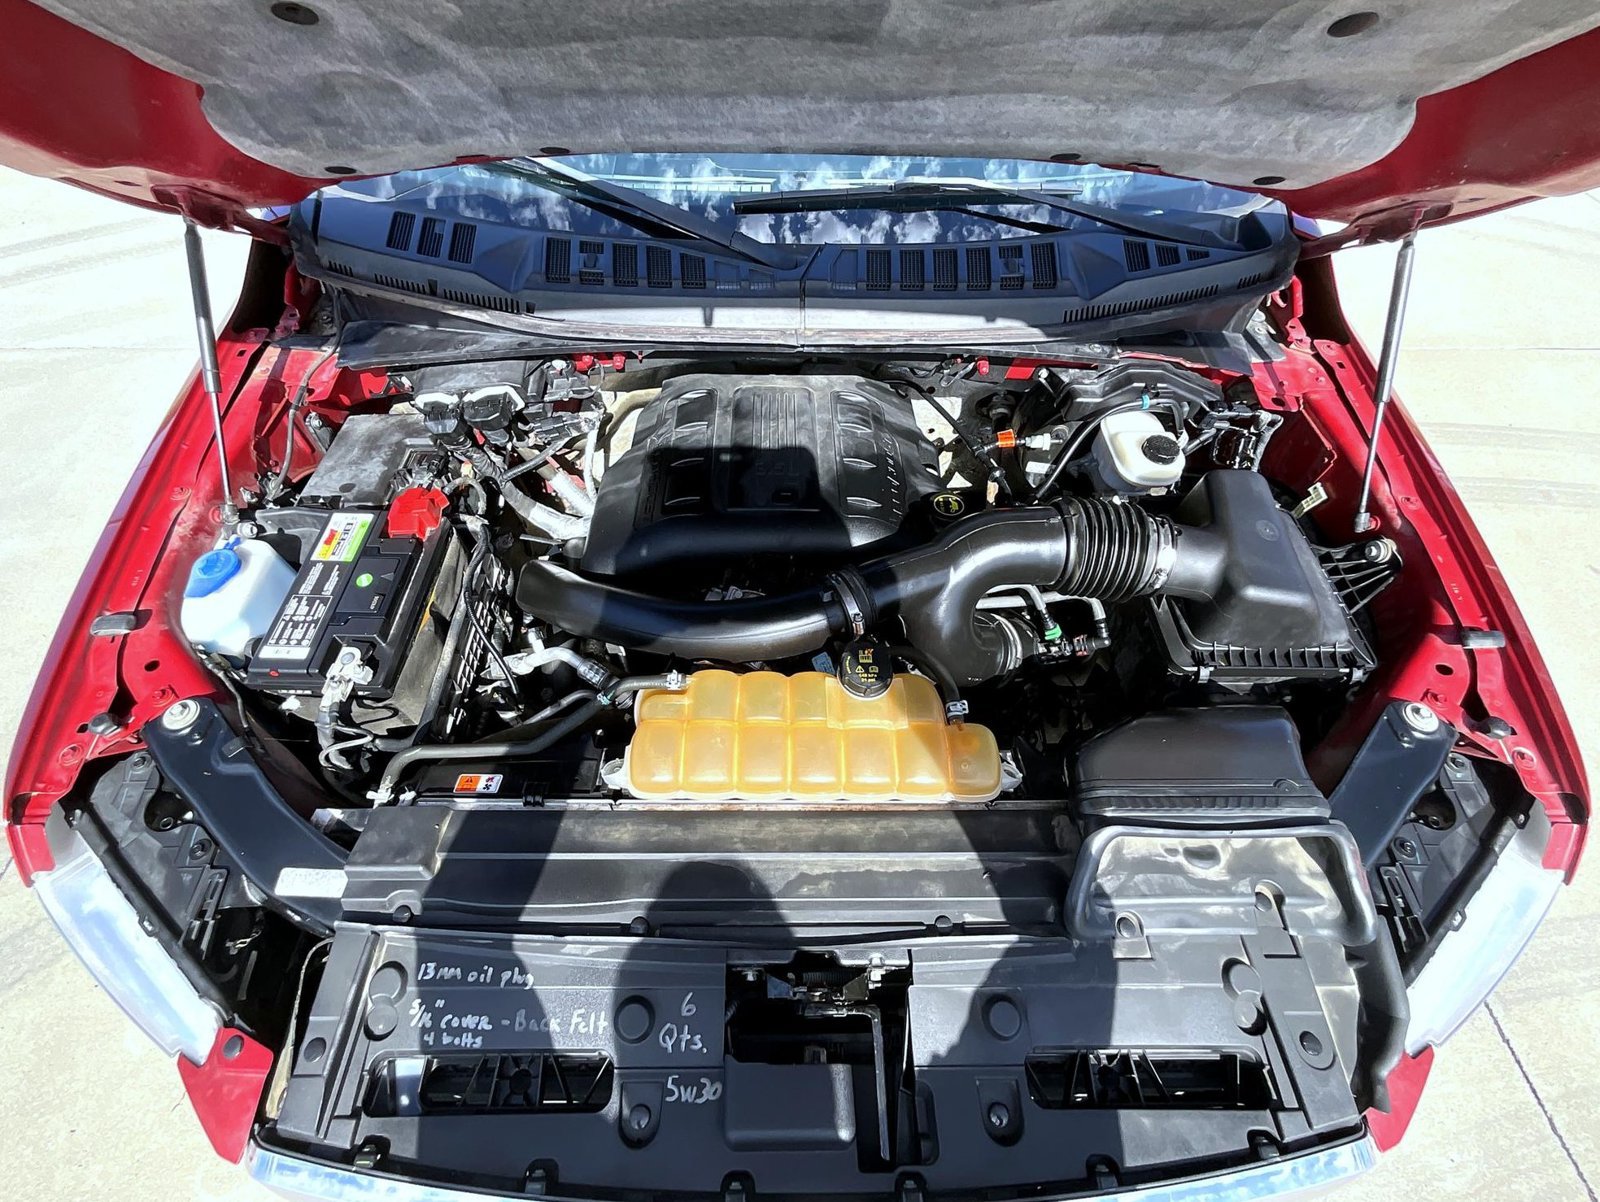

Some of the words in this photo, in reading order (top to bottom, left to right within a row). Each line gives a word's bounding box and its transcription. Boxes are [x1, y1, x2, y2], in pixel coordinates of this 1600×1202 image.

[467, 965, 494, 984] oil
[500, 966, 535, 990] plug
[681, 991, 697, 1017] 6
[568, 1007, 609, 1035] Felt
[423, 1031, 436, 1046] 4
[659, 1022, 708, 1054] Qts.
